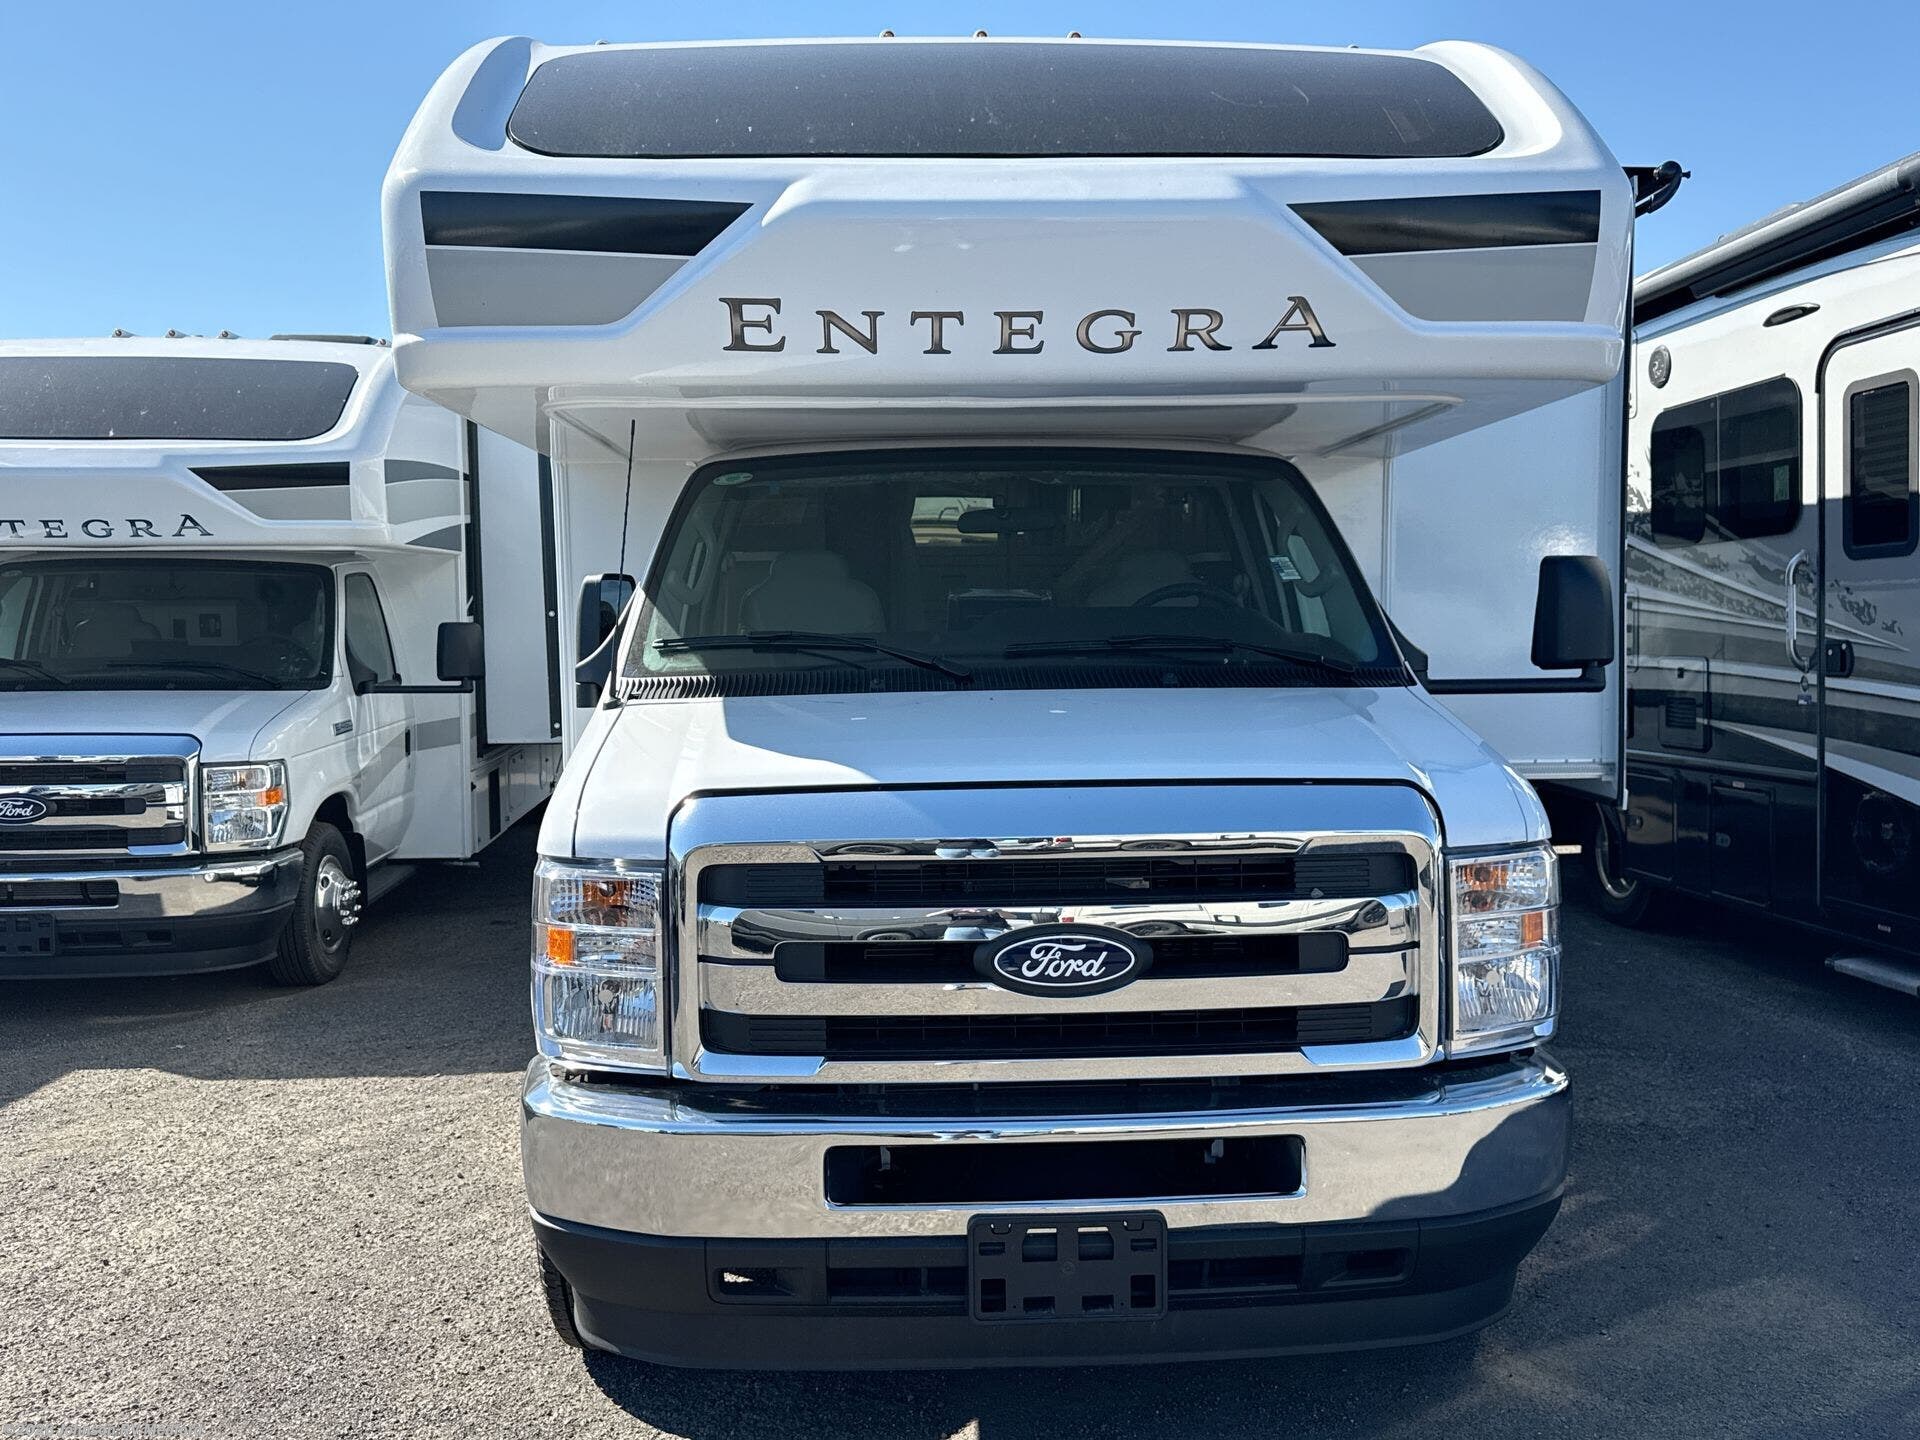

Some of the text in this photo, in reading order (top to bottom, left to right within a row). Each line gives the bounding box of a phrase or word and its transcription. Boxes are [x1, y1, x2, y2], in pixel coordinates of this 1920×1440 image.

[718, 295, 1337, 355] ENTEGRA
[0, 800, 34, 816] Ford
[1021, 942, 1108, 978] Ford
